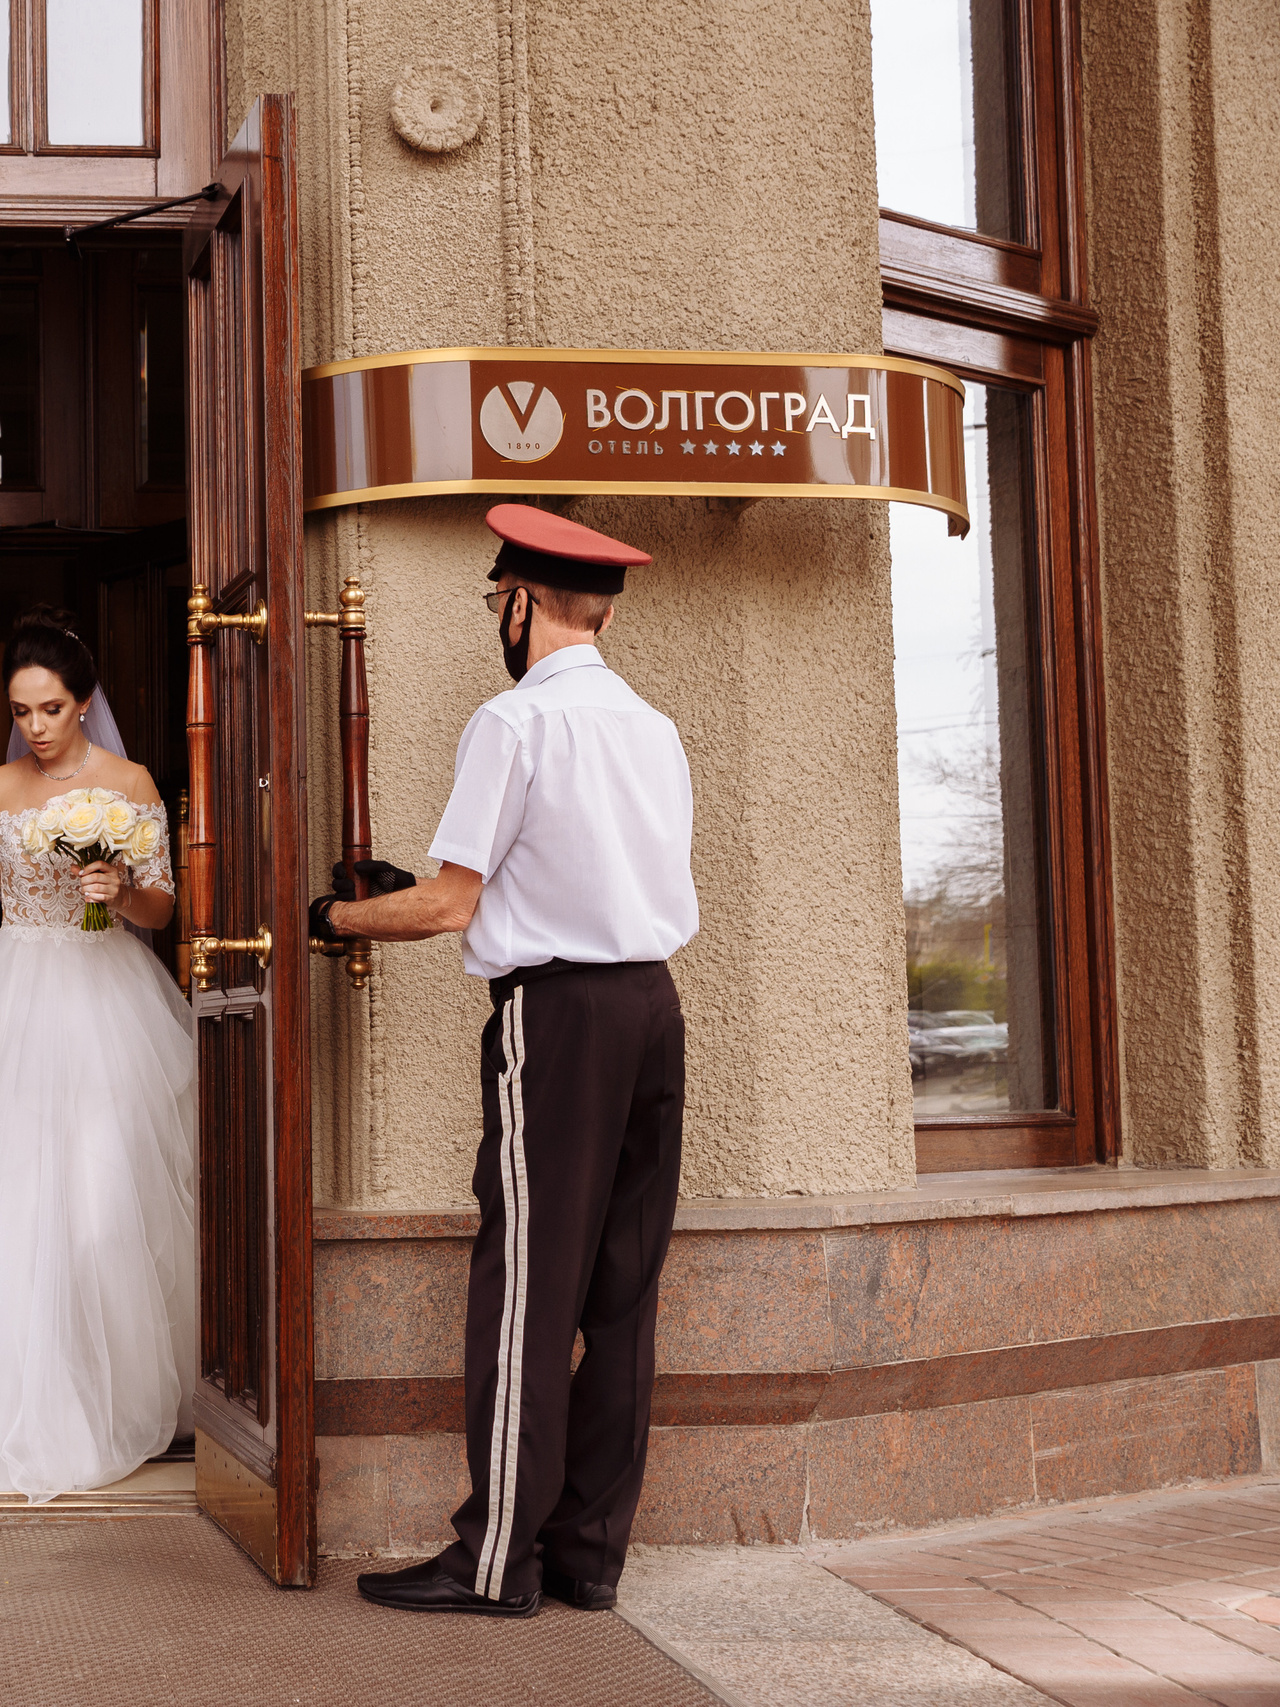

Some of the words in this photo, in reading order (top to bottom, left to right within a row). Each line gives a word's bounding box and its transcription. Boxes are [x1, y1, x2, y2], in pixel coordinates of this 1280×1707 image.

[586, 388, 876, 441] ВОЛГОГРАД
[508, 442, 540, 450] 1890
[588, 440, 664, 455] ОТЕЛЬ
